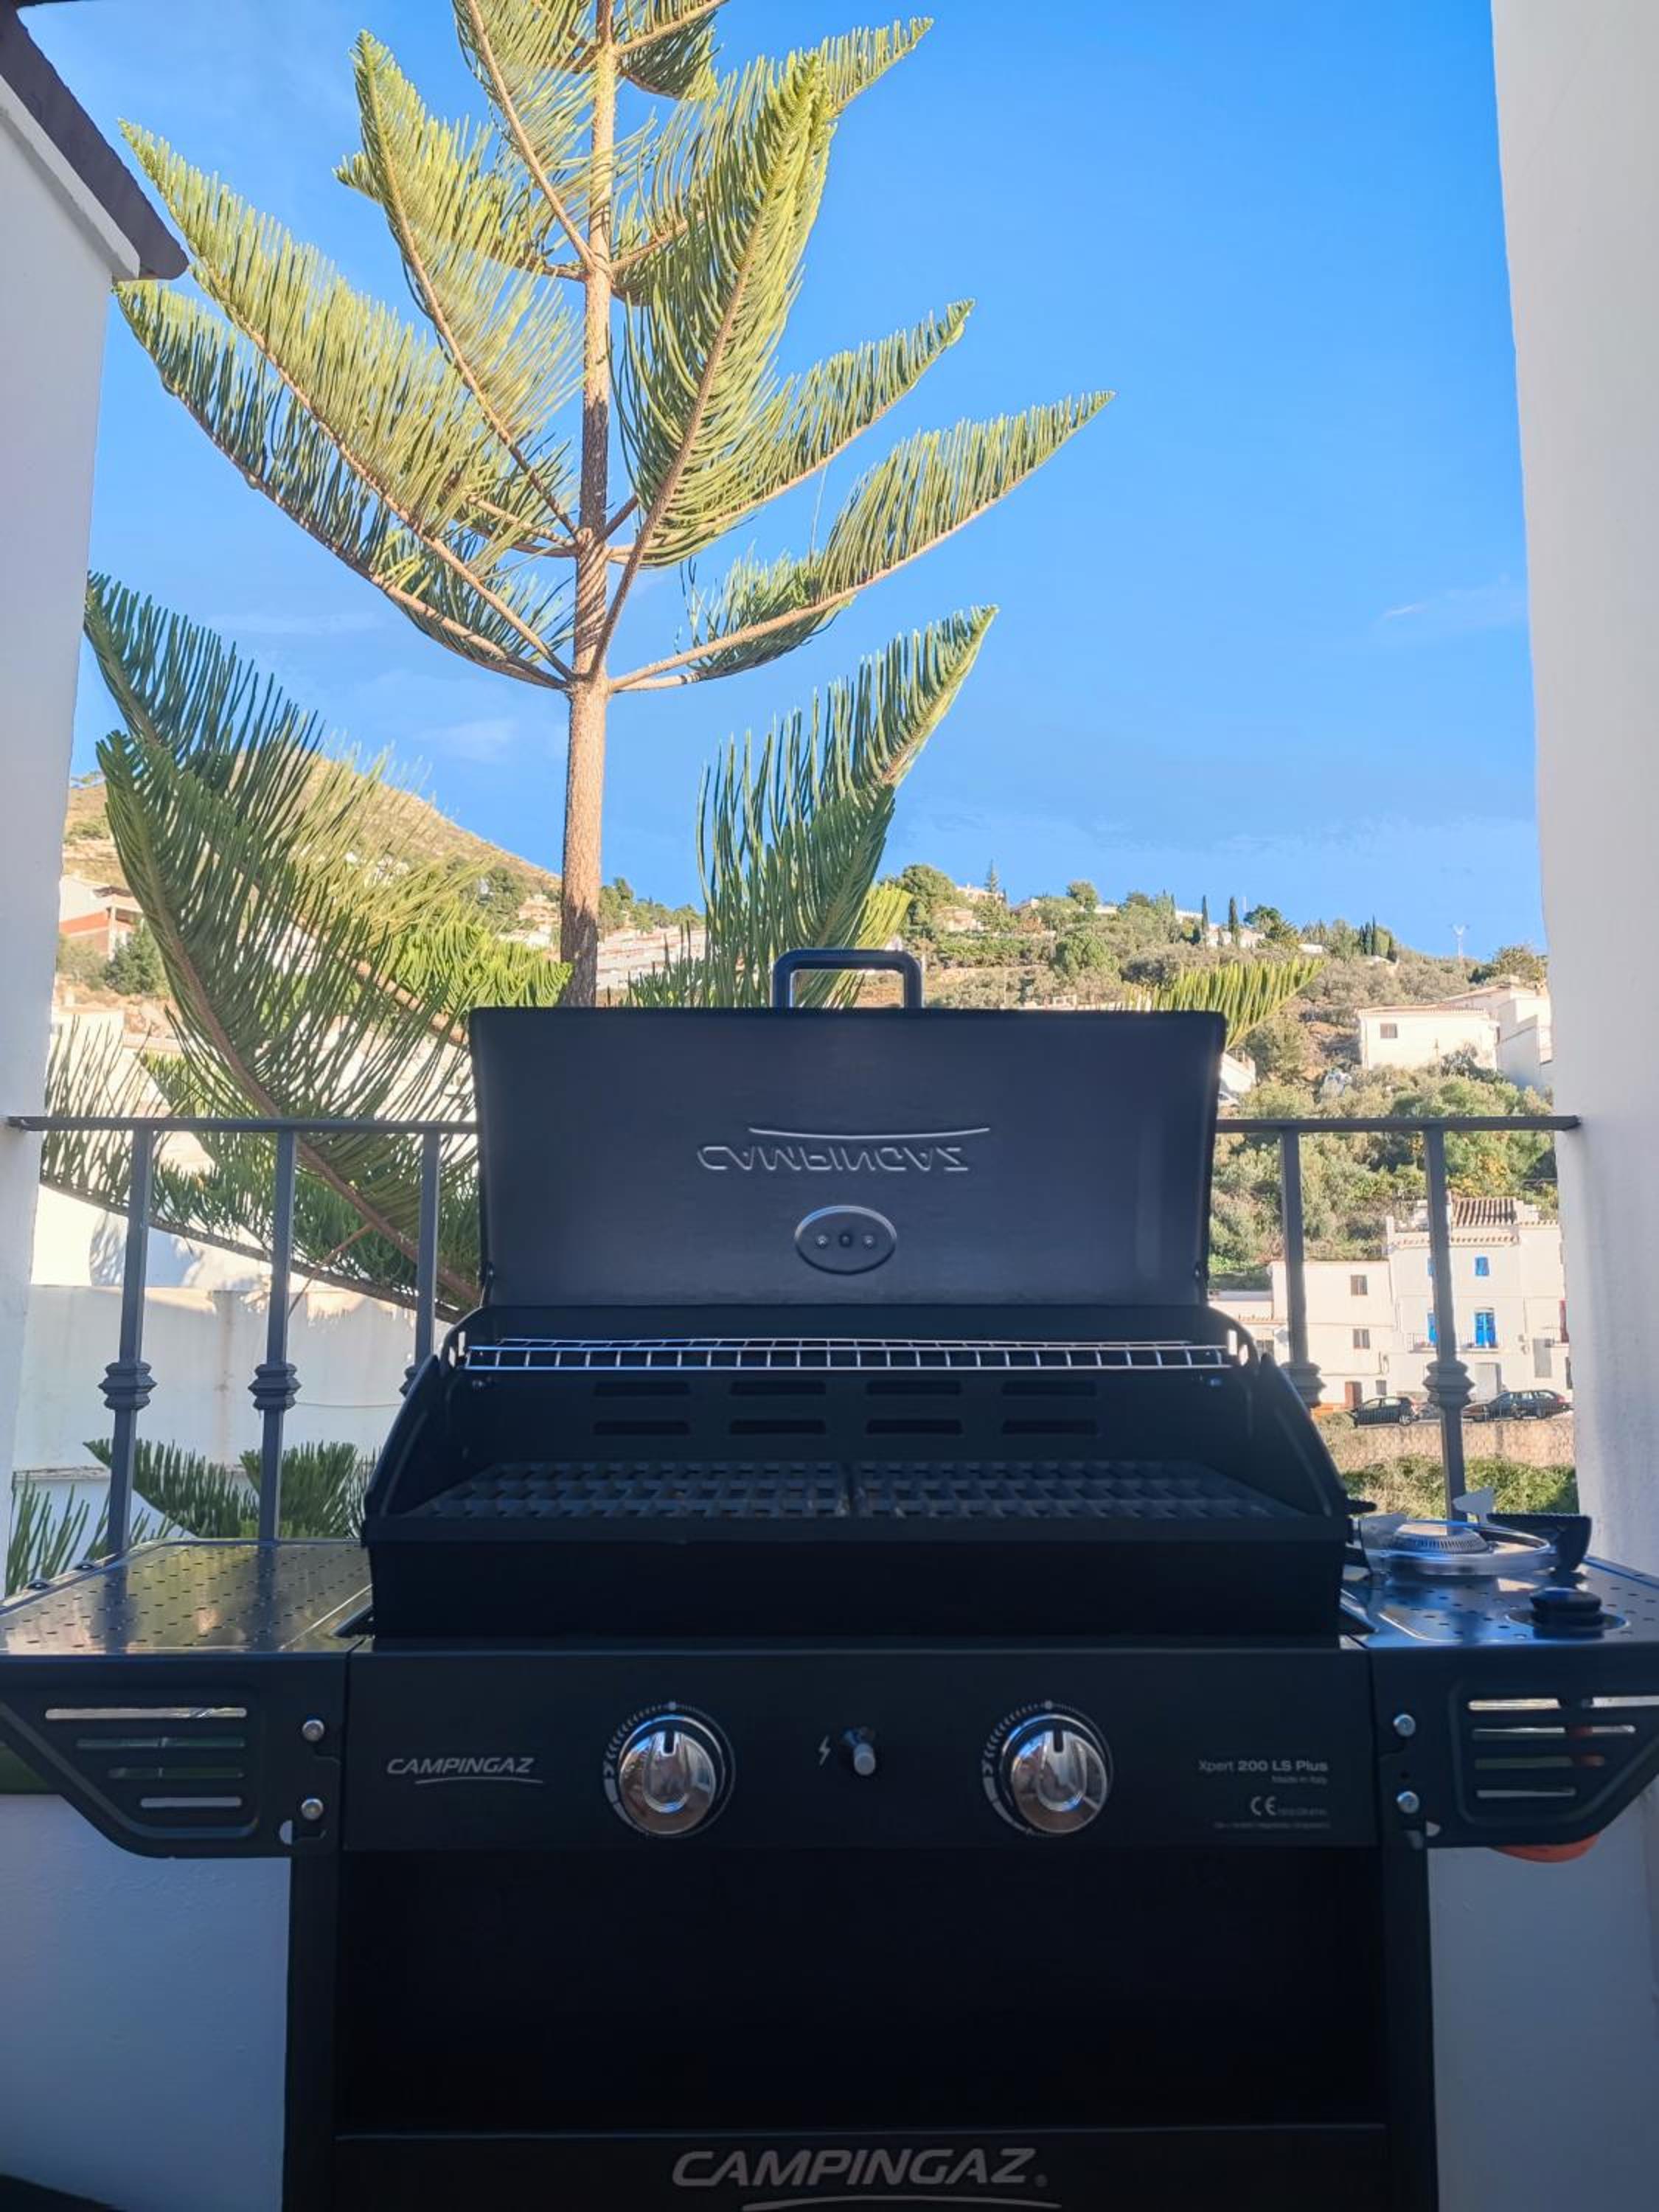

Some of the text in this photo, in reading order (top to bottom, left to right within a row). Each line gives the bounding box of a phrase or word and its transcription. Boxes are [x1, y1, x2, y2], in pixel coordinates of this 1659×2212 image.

[387, 1758, 535, 1774] CAMPINGAZ
[1199, 1760, 1328, 1773] Xpert 200 LS Plus
[1251, 1796, 1277, 1816] CE
[672, 2147, 1036, 2187] CAMPINGAZ
